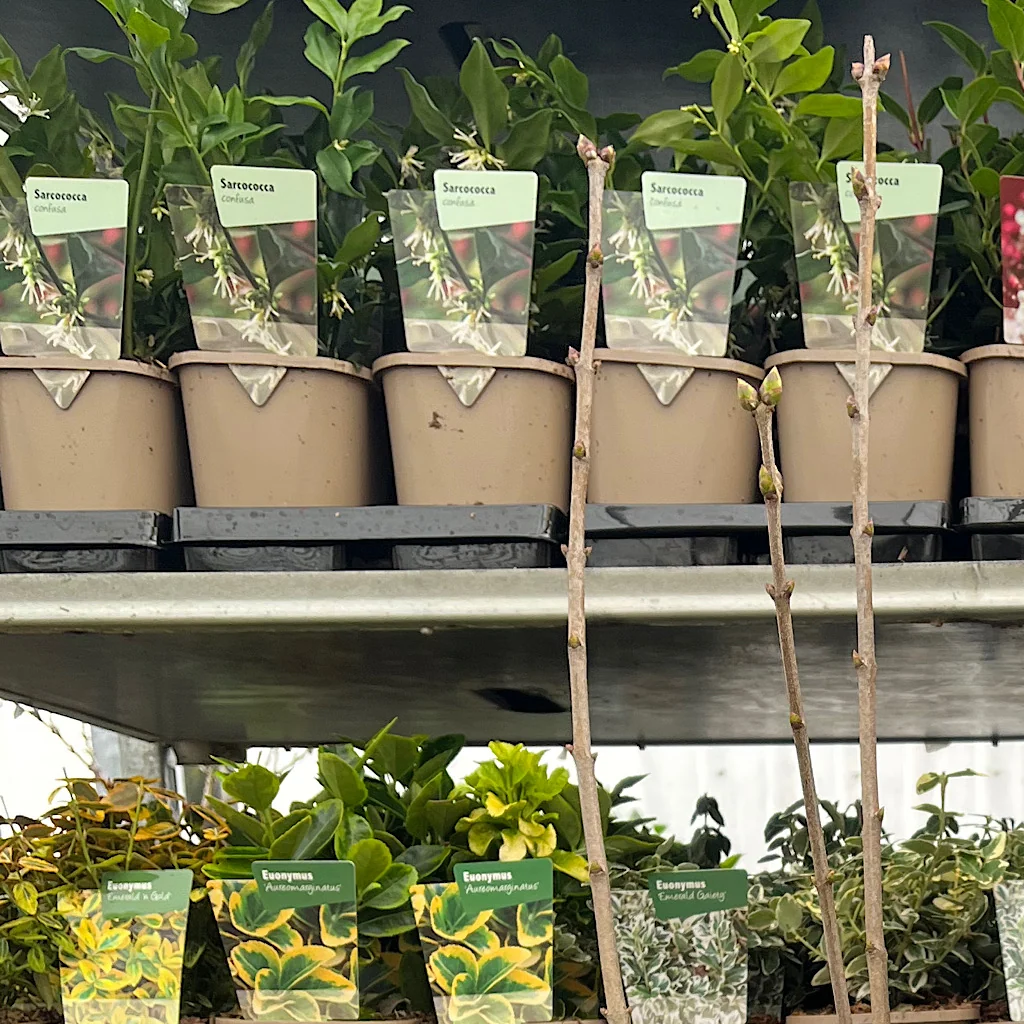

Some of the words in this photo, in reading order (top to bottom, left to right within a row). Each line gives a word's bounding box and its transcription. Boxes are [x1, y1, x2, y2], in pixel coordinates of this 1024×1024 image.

[221, 178, 275, 192] Sarcococca
[443, 182, 496, 194] Sarcococca
[650, 182, 704, 196] Sarcococca
[34, 188, 87, 201] Sarcococca
[221, 193, 254, 204] confusa
[262, 869, 313, 883] Euonymus
[463, 871, 512, 883] Euonymus
[107, 880, 153, 892] Euonymus
[656, 880, 706, 892] Euonymus
